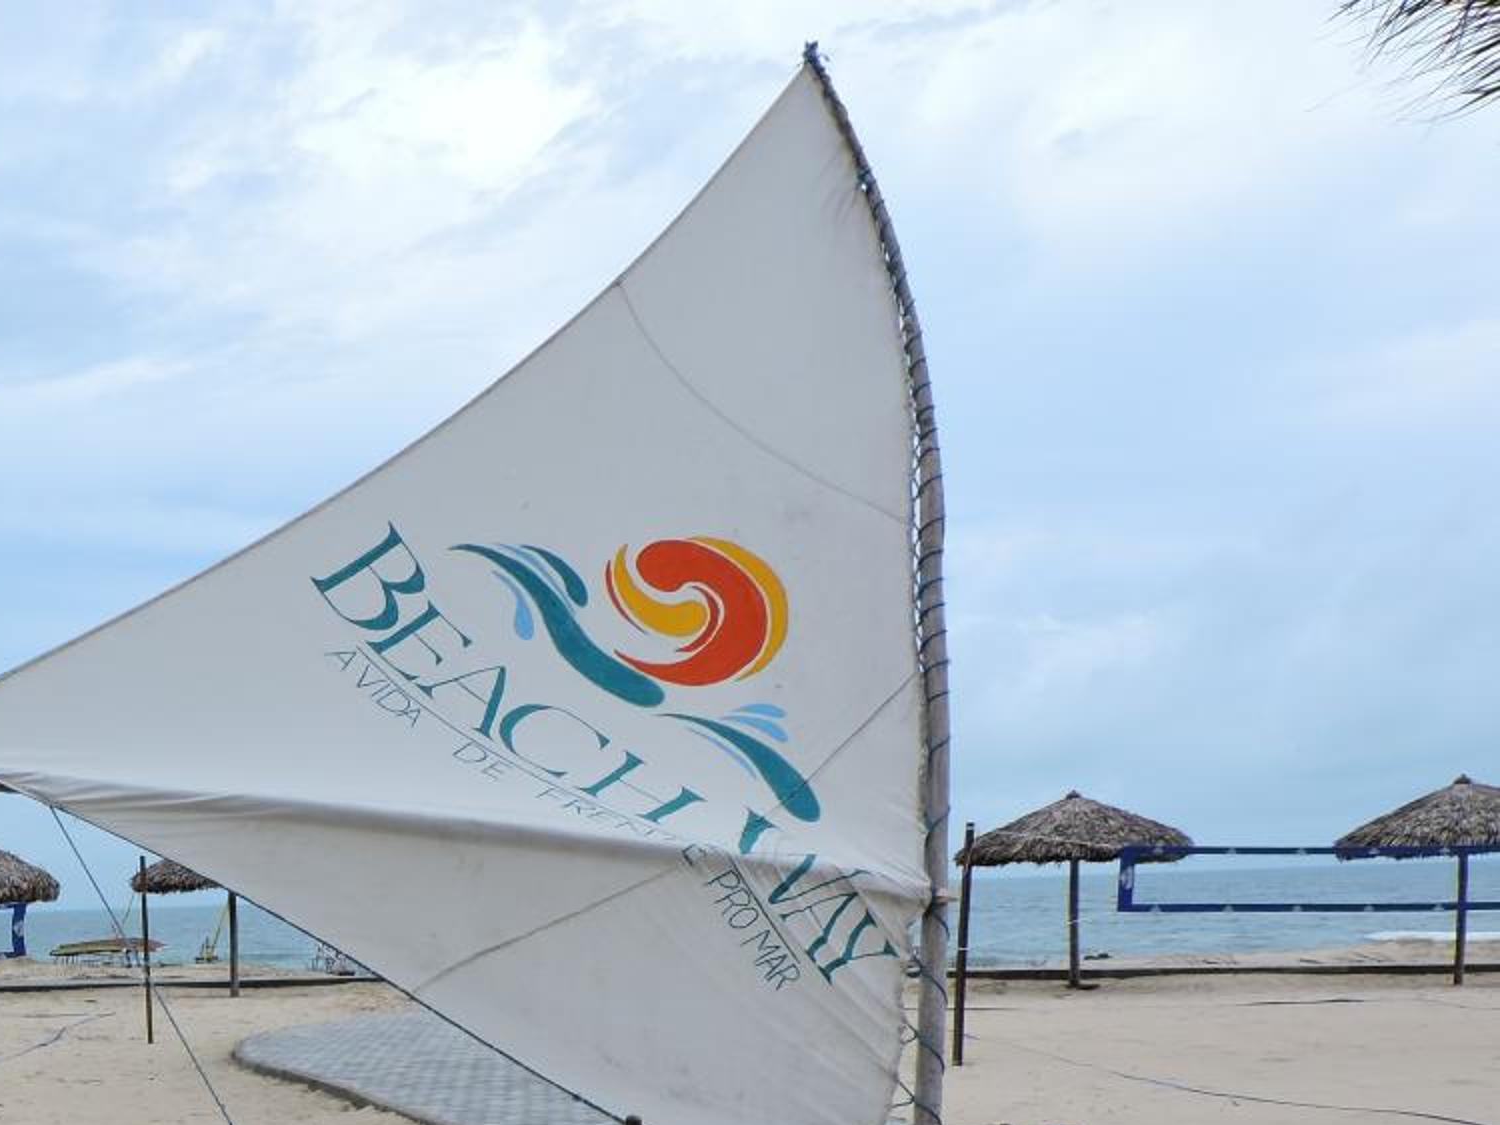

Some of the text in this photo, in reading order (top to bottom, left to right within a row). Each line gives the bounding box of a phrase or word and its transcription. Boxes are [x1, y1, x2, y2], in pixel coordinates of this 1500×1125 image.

[310, 520, 900, 985] BEACH WAY
[324, 651, 357, 672] A
[356, 663, 421, 728] VIDA
[452, 740, 510, 782] DE
[706, 869, 759, 930] PRO
[740, 929, 800, 990] MAR
